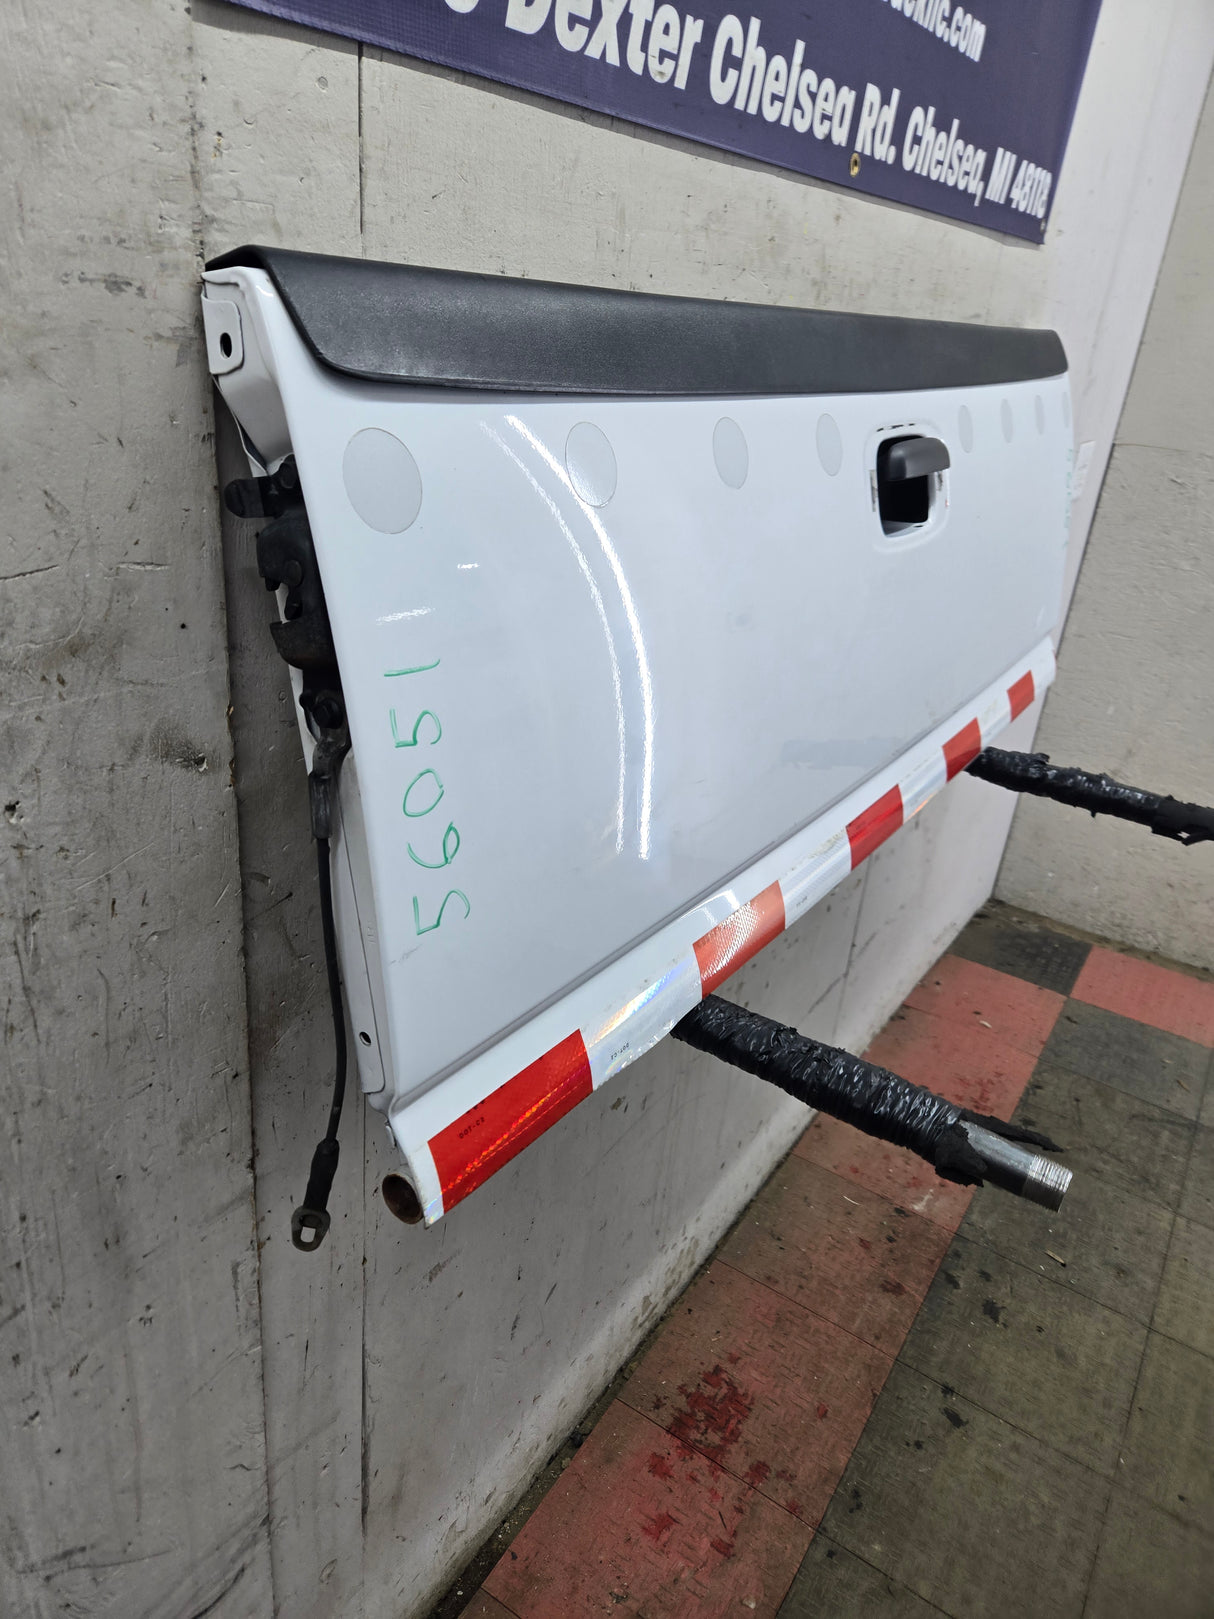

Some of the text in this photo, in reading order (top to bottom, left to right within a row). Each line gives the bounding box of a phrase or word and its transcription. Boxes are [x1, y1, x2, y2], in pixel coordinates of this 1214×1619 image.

[710, 14, 857, 147] Chelsea
[854, 82, 901, 165] Rd.
[902, 106, 987, 207] Chelsea,
[985, 147, 1018, 204] MI
[384, 659, 470, 935] 56051
